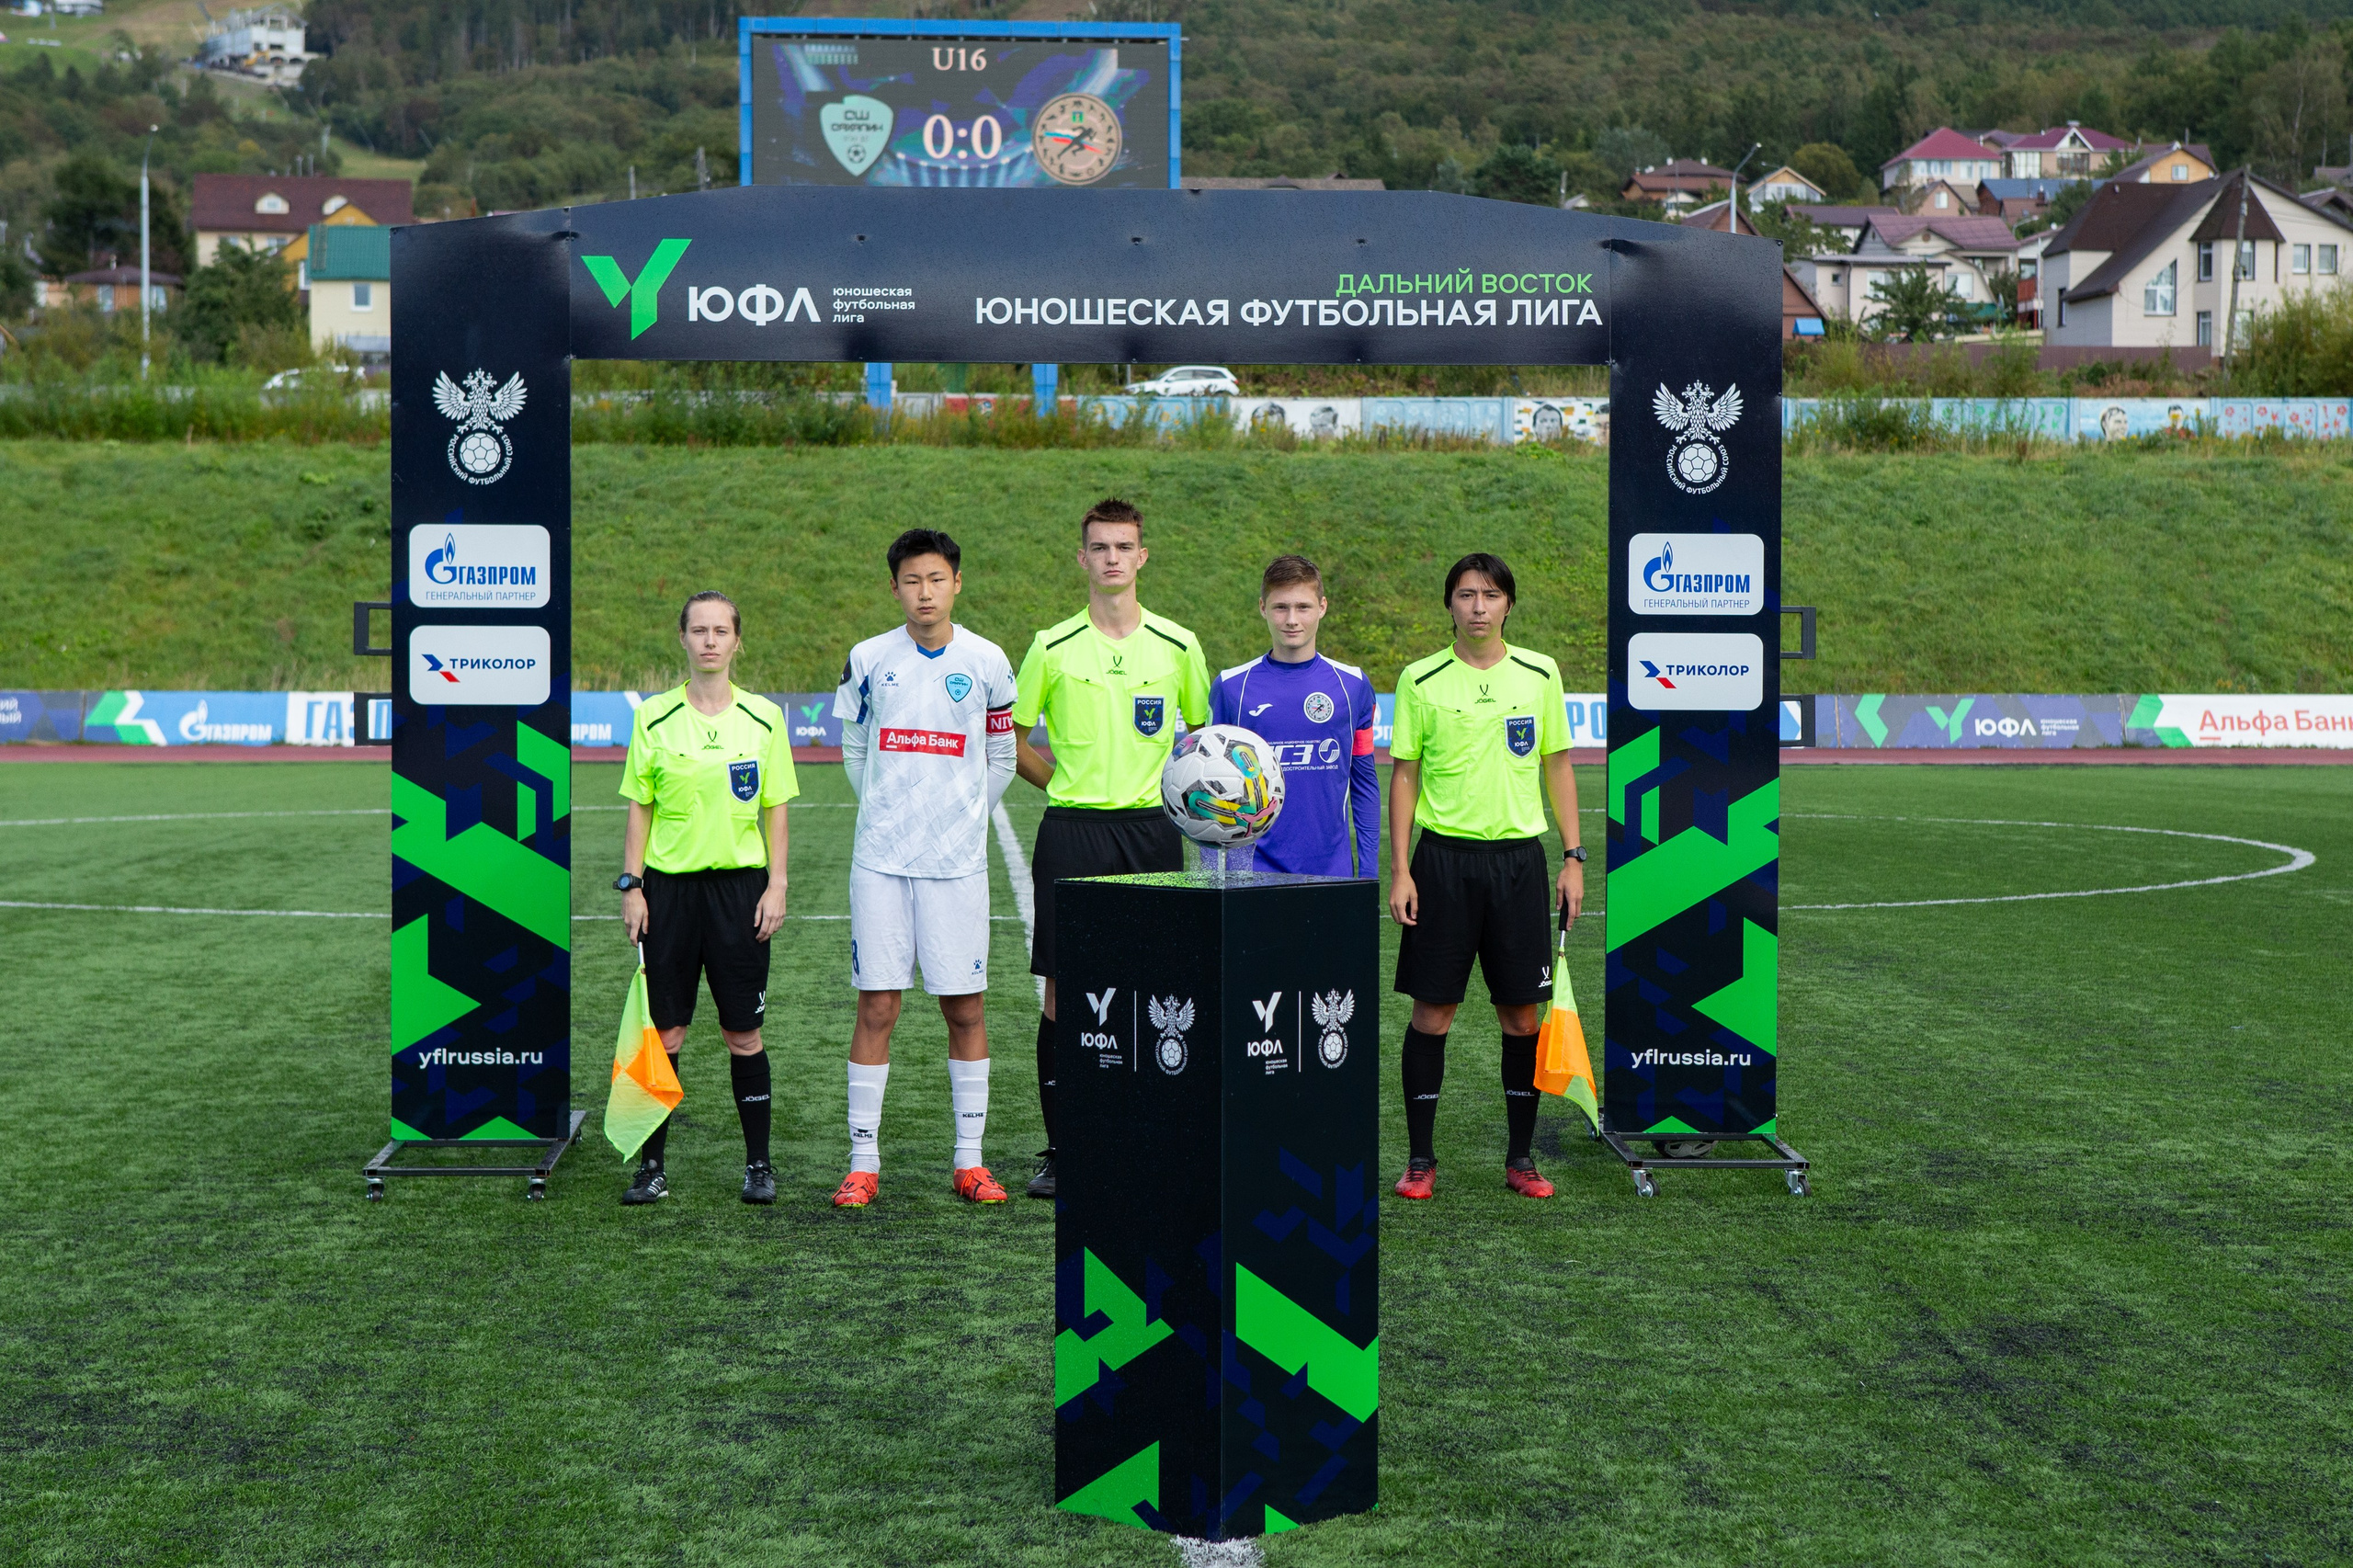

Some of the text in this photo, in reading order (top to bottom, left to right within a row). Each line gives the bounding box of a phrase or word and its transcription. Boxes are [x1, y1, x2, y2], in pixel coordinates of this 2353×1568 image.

[931, 48, 987, 72] U16
[922, 114, 1002, 160] 0:0
[1336, 267, 1593, 298] ДАЛЬНИЙ ВОСТОК
[833, 287, 913, 298] юношеская
[688, 284, 821, 325] ЮФЛ
[833, 300, 915, 312] футбольная
[976, 297, 1603, 327] ЮНОШЕСКАЯ ФУТБОЛЬНАЯ ЛИГА
[833, 313, 864, 324] лига
[459, 566, 536, 585] ГАЗПРОМ
[1676, 574, 1750, 593] ГАЗПРОМ
[426, 590, 536, 601] ГЕНЕРАЛЬНЫЙ ПАРТНЕР
[1643, 598, 1750, 608] ГЕНЕРАЛЬНЫЙ ПАРТНЕР
[449, 658, 536, 669] ТРИКОЛОР
[1666, 665, 1749, 676] ТРИКОЛОР
[207, 723, 272, 741] ГАЗПРОМ
[796, 726, 826, 737] ЮФЛ
[1975, 717, 2037, 738] ЮФЛ
[2200, 710, 2289, 736] Альфа
[886, 732, 959, 749] Альфа Банк
[732, 763, 756, 771] РОССИЯ
[1081, 1032, 1118, 1050] ЮФЛ
[1247, 1039, 1283, 1057] ЮФЛ
[418, 1048, 543, 1069] yflrussia.ru
[1631, 1049, 1751, 1069] yflrussia.ru
